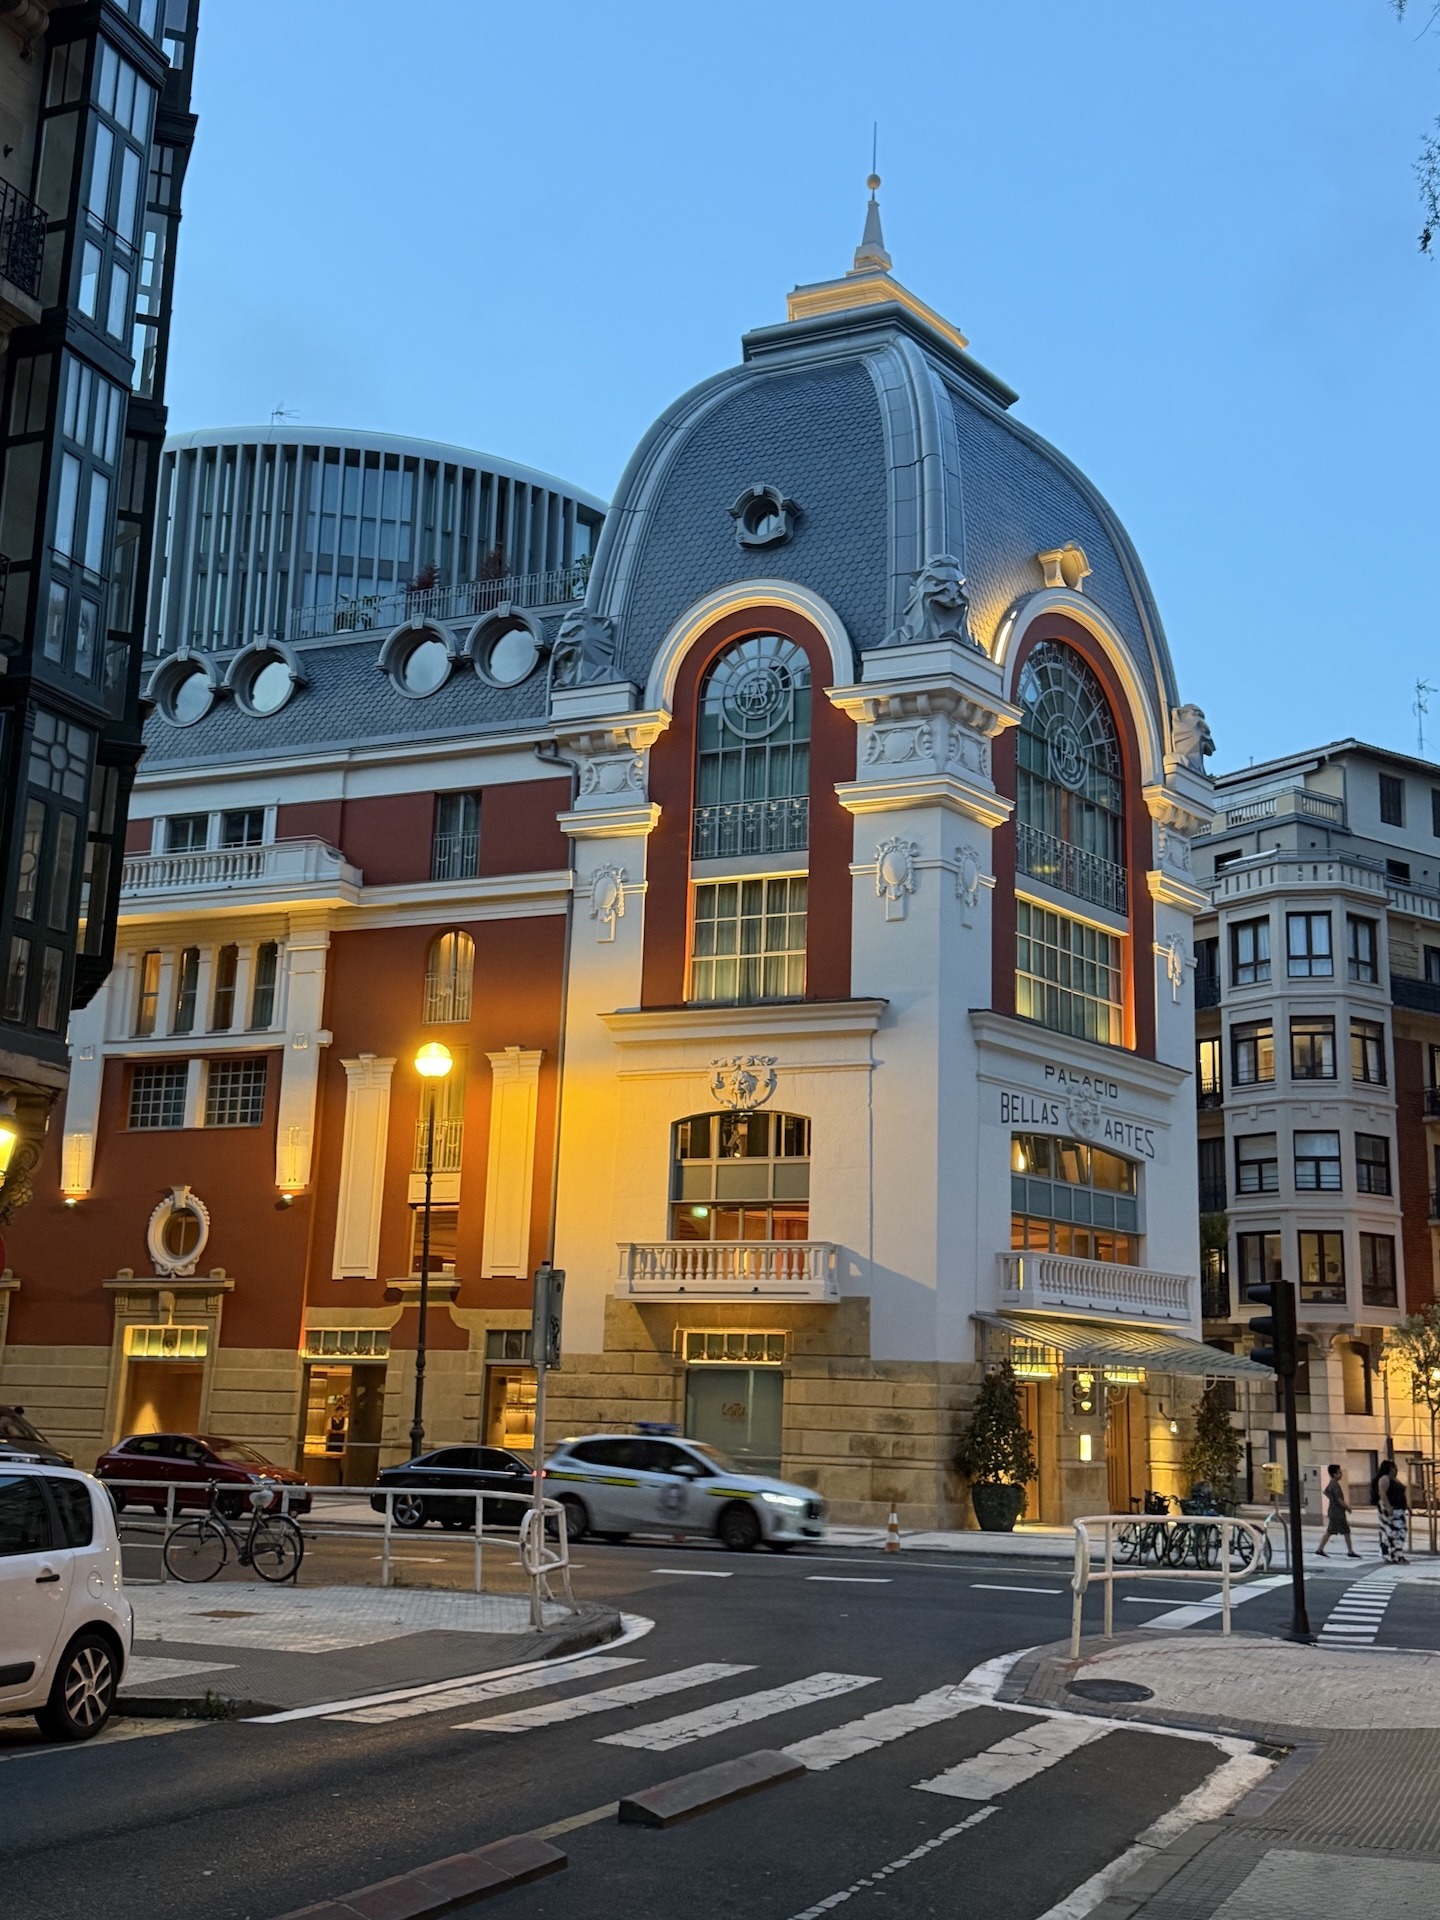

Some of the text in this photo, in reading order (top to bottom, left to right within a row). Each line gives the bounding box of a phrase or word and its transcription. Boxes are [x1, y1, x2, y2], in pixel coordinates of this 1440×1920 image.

[1044, 1064, 1118, 1099] PALACIO
[1000, 1091, 1155, 1159] BELLAS ARTES
